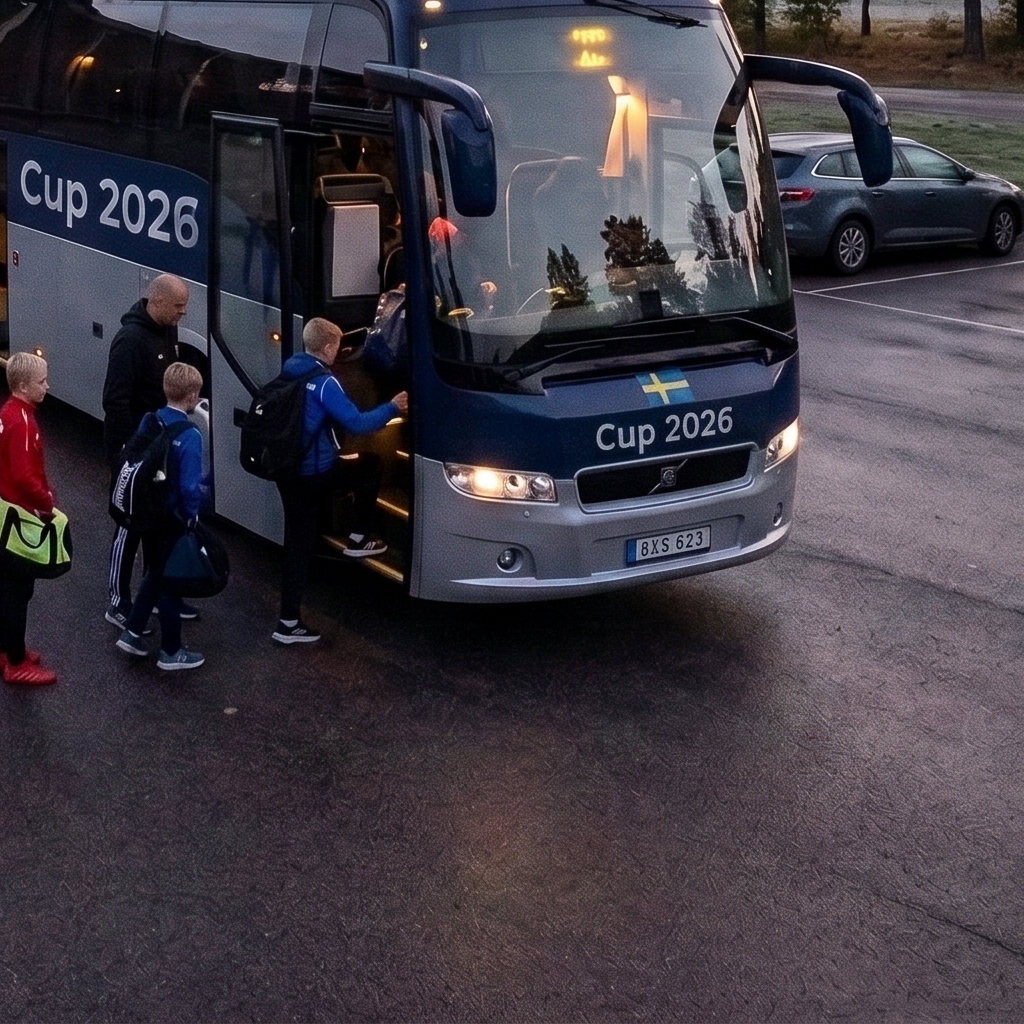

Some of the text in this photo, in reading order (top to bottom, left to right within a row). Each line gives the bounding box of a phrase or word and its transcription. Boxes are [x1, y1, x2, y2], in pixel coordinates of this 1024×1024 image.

[20, 159, 199, 249] Cup 2026
[596, 406, 733, 454] Cup 2026
[676, 531, 703, 550] 623
